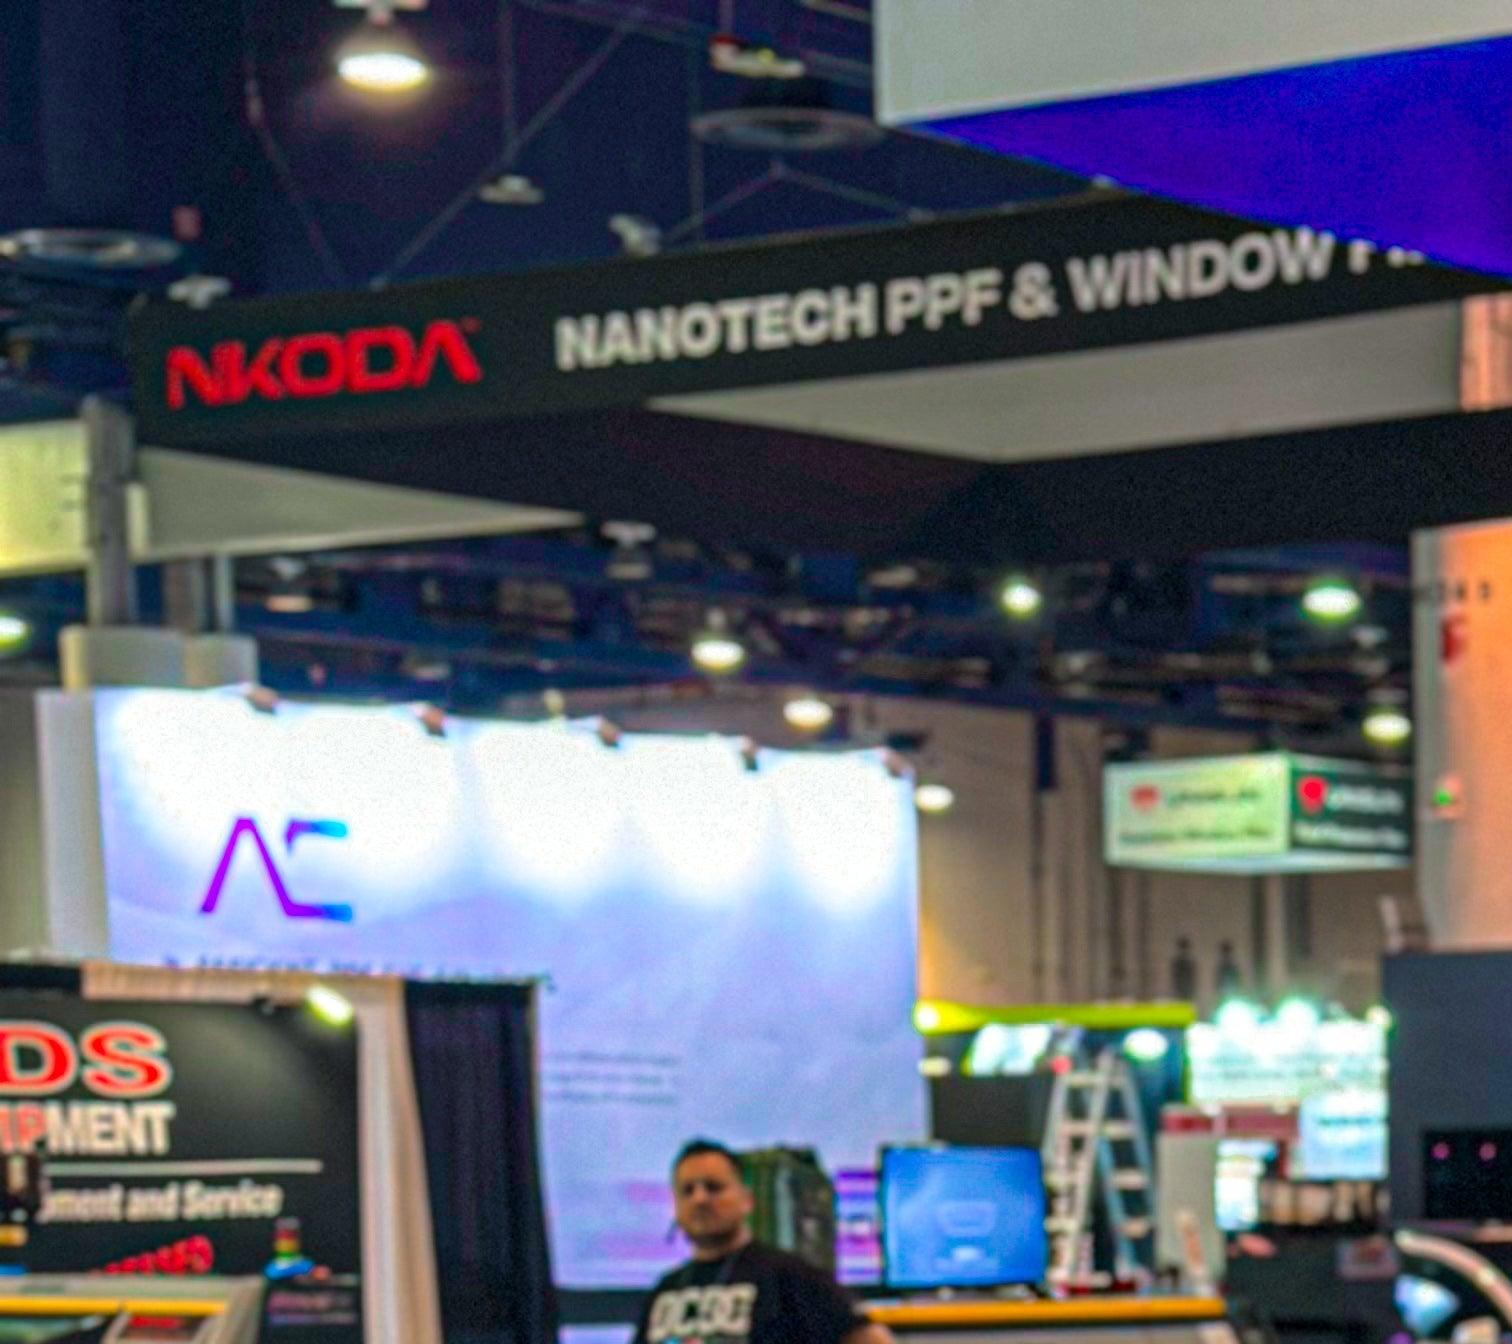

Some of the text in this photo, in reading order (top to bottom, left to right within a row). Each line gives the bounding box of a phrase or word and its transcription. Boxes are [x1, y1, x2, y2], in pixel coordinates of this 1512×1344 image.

[554, 283, 879, 371] NANOTECH
[884, 267, 1003, 335] PPF
[1009, 262, 1059, 320] &
[1066, 227, 1335, 313] WINDOW
[166, 320, 482, 410] NKODA
